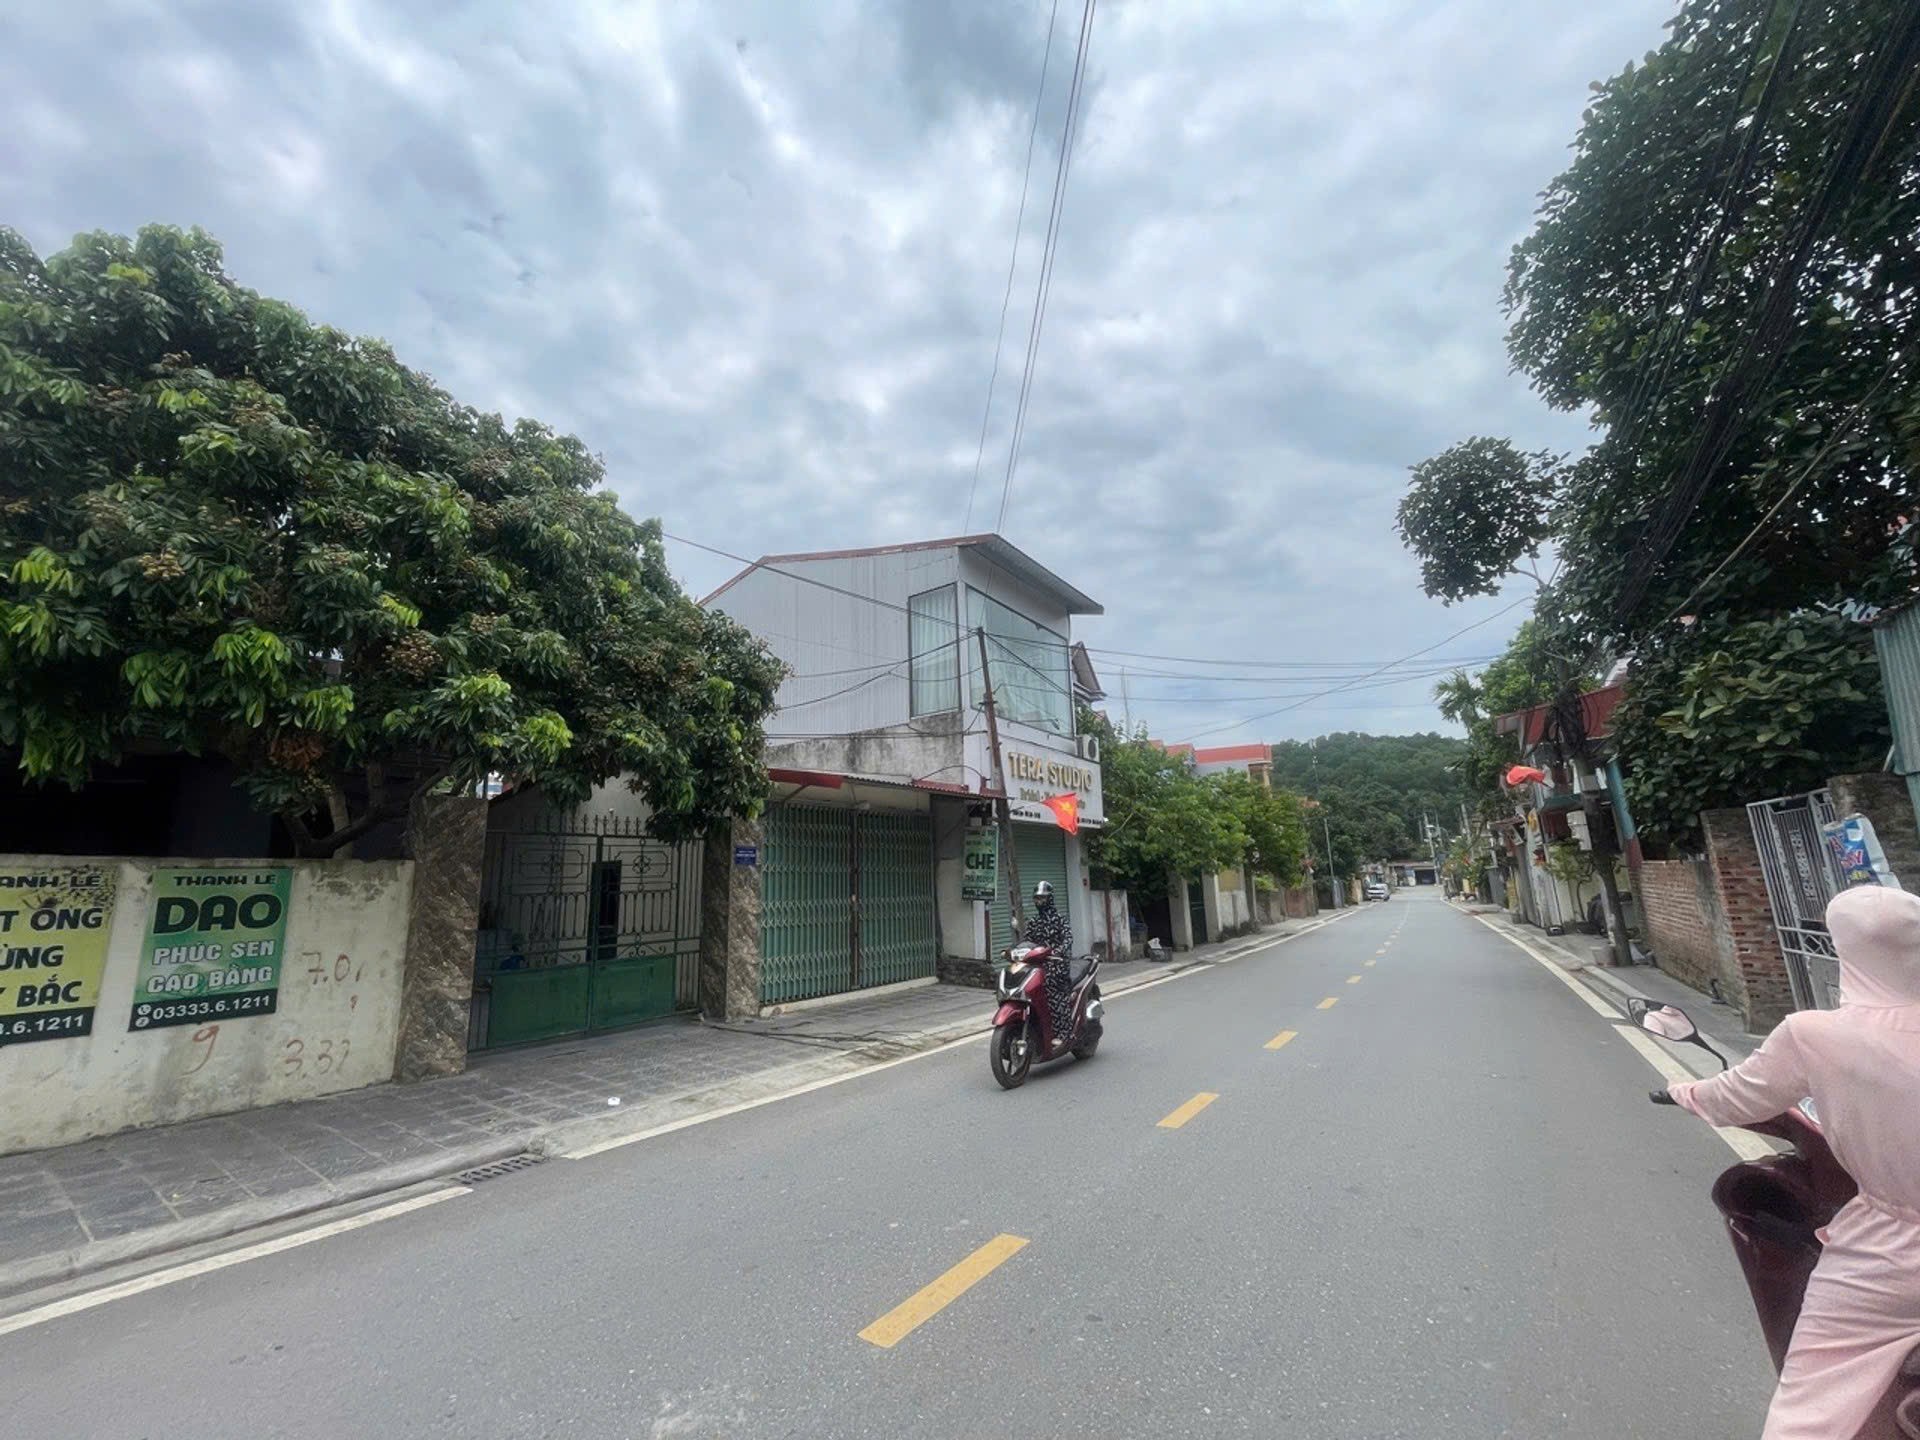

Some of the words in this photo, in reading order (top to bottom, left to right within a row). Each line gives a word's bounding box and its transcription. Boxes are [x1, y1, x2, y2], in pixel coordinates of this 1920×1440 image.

[1008, 752, 1043, 783] TERA
[1047, 761, 1093, 792] STUDIO
[174, 876, 247, 886] THANH
[153, 894, 282, 934] DAO
[153, 942, 222, 965] PHÚC
[231, 940, 275, 958] SEN
[17, 974, 82, 1008] BẮC
[148, 973, 200, 993] CAO
[152, 995, 270, 1020] 03333.6.1211
